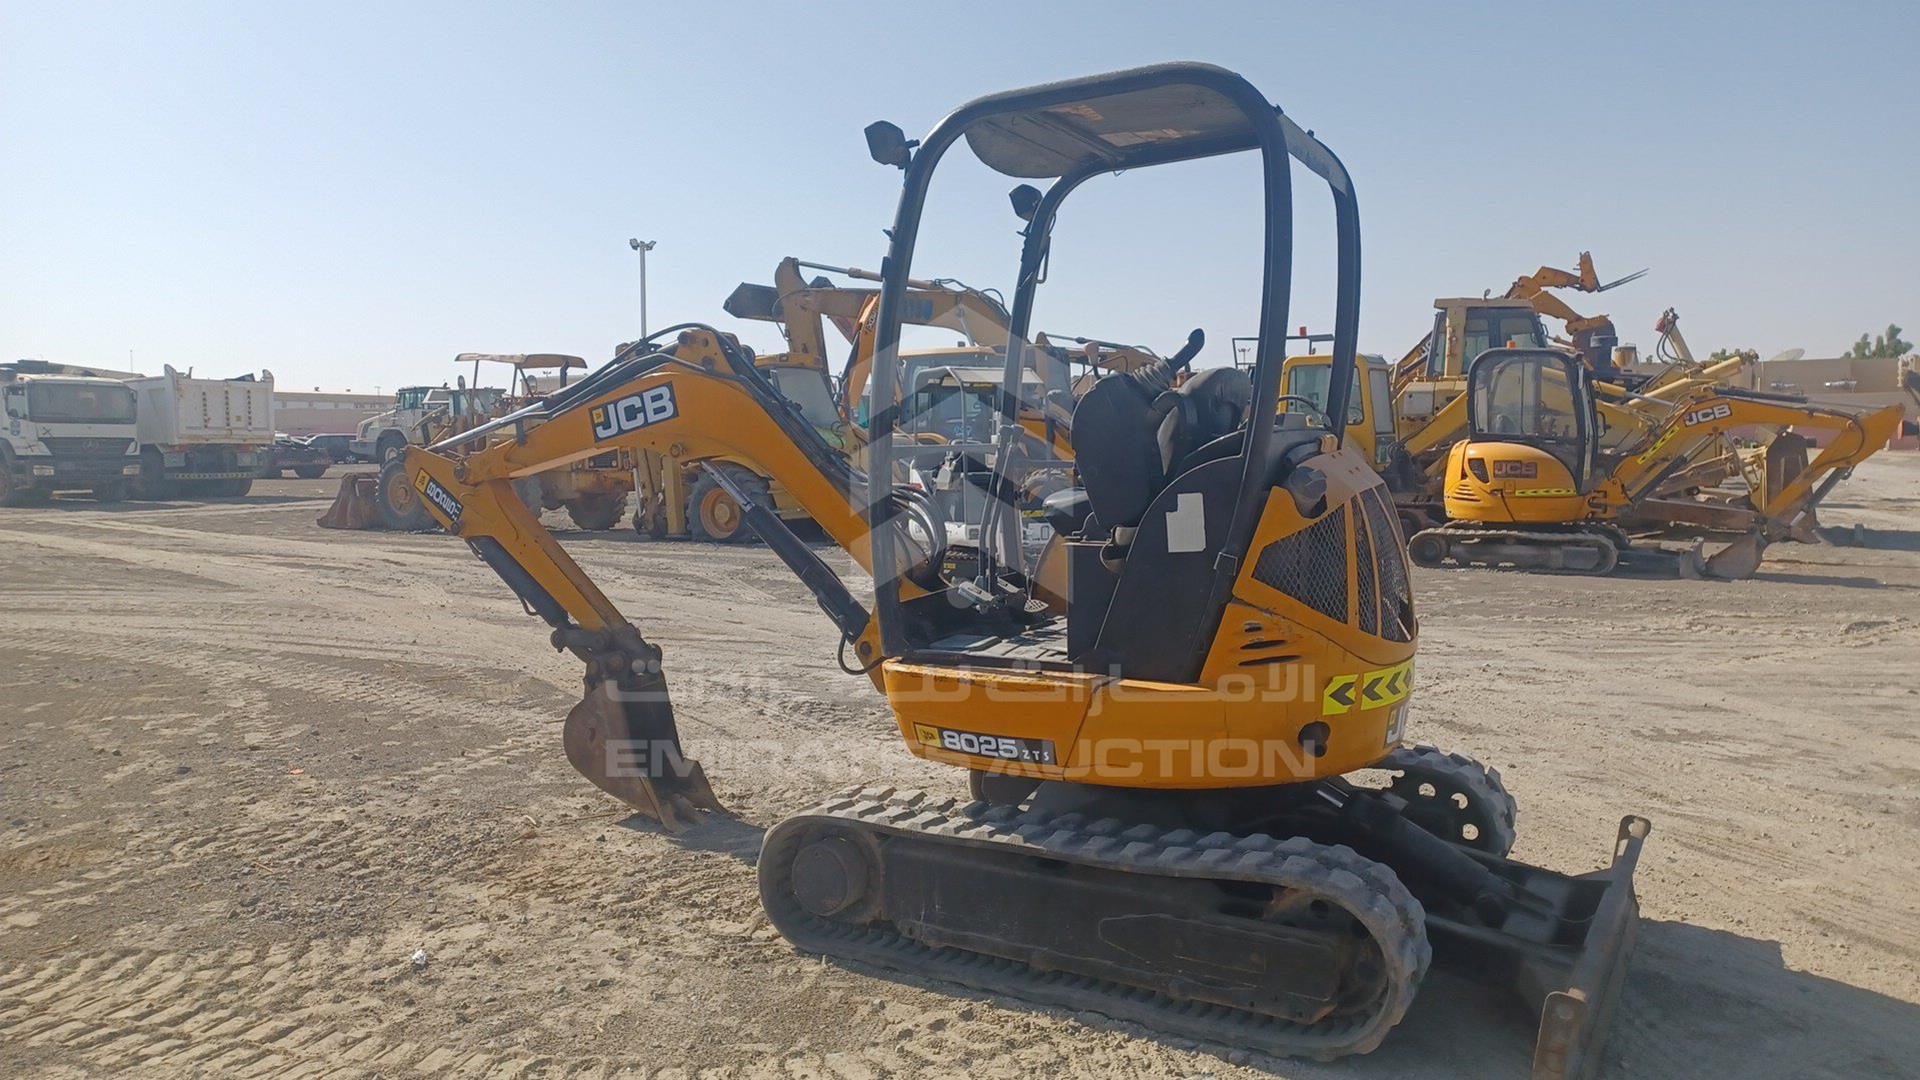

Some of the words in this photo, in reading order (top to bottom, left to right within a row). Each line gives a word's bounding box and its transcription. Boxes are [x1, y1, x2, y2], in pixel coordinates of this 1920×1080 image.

[595, 386, 675, 438] JCB
[1684, 404, 1731, 426] JCB
[1494, 461, 1537, 475] JCB
[942, 730, 1024, 758] 8025
